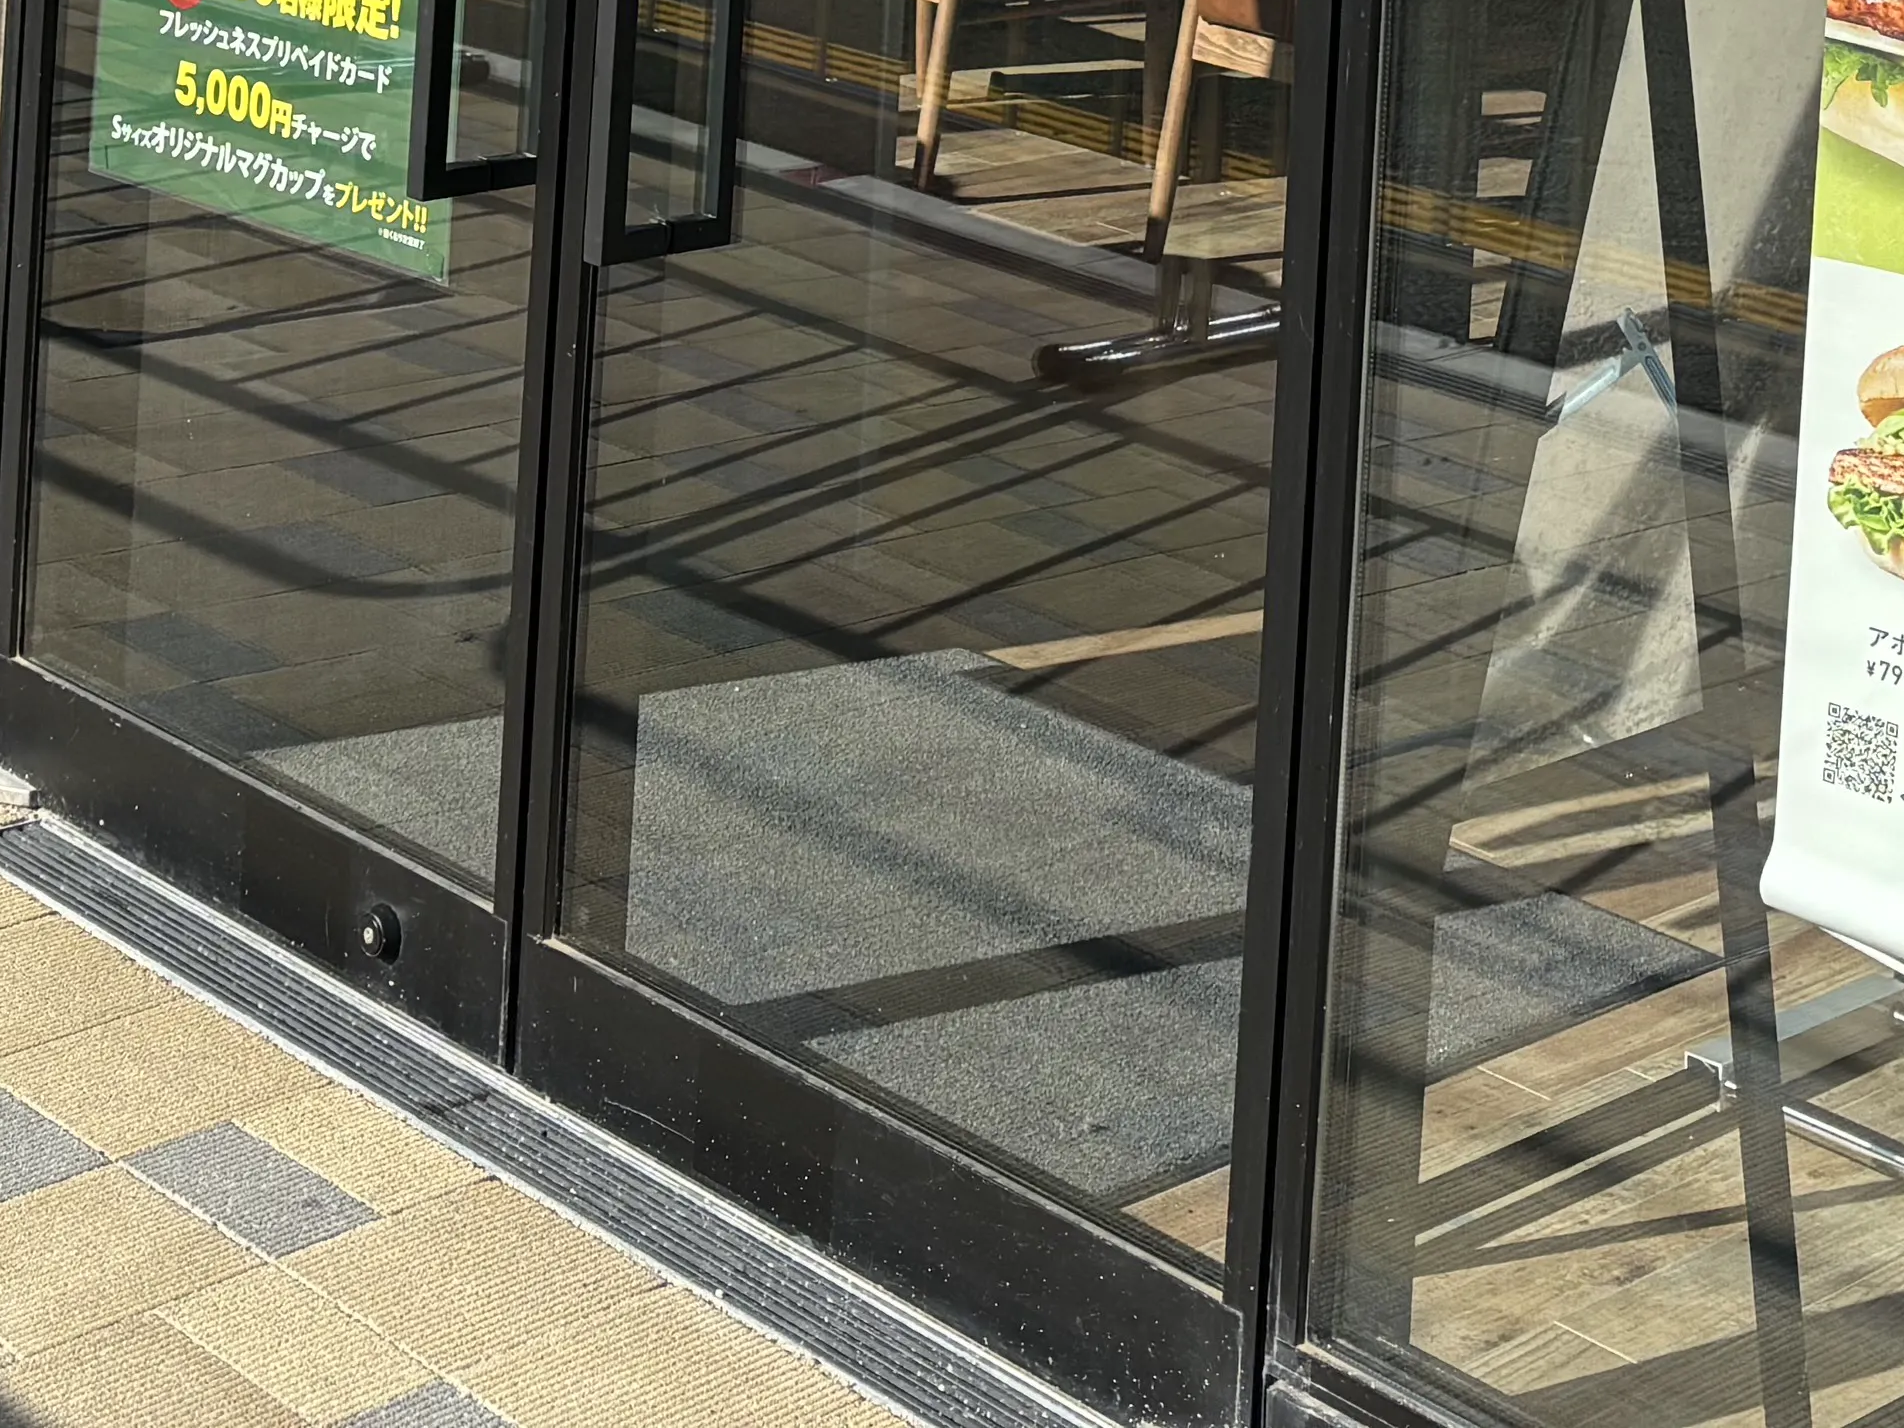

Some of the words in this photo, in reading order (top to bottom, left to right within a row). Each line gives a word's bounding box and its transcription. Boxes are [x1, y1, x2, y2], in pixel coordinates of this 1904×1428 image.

[159, 8, 392, 94] フレッシュネスプリペイドカード
[174, 59, 377, 161] 5,000円チャージで
